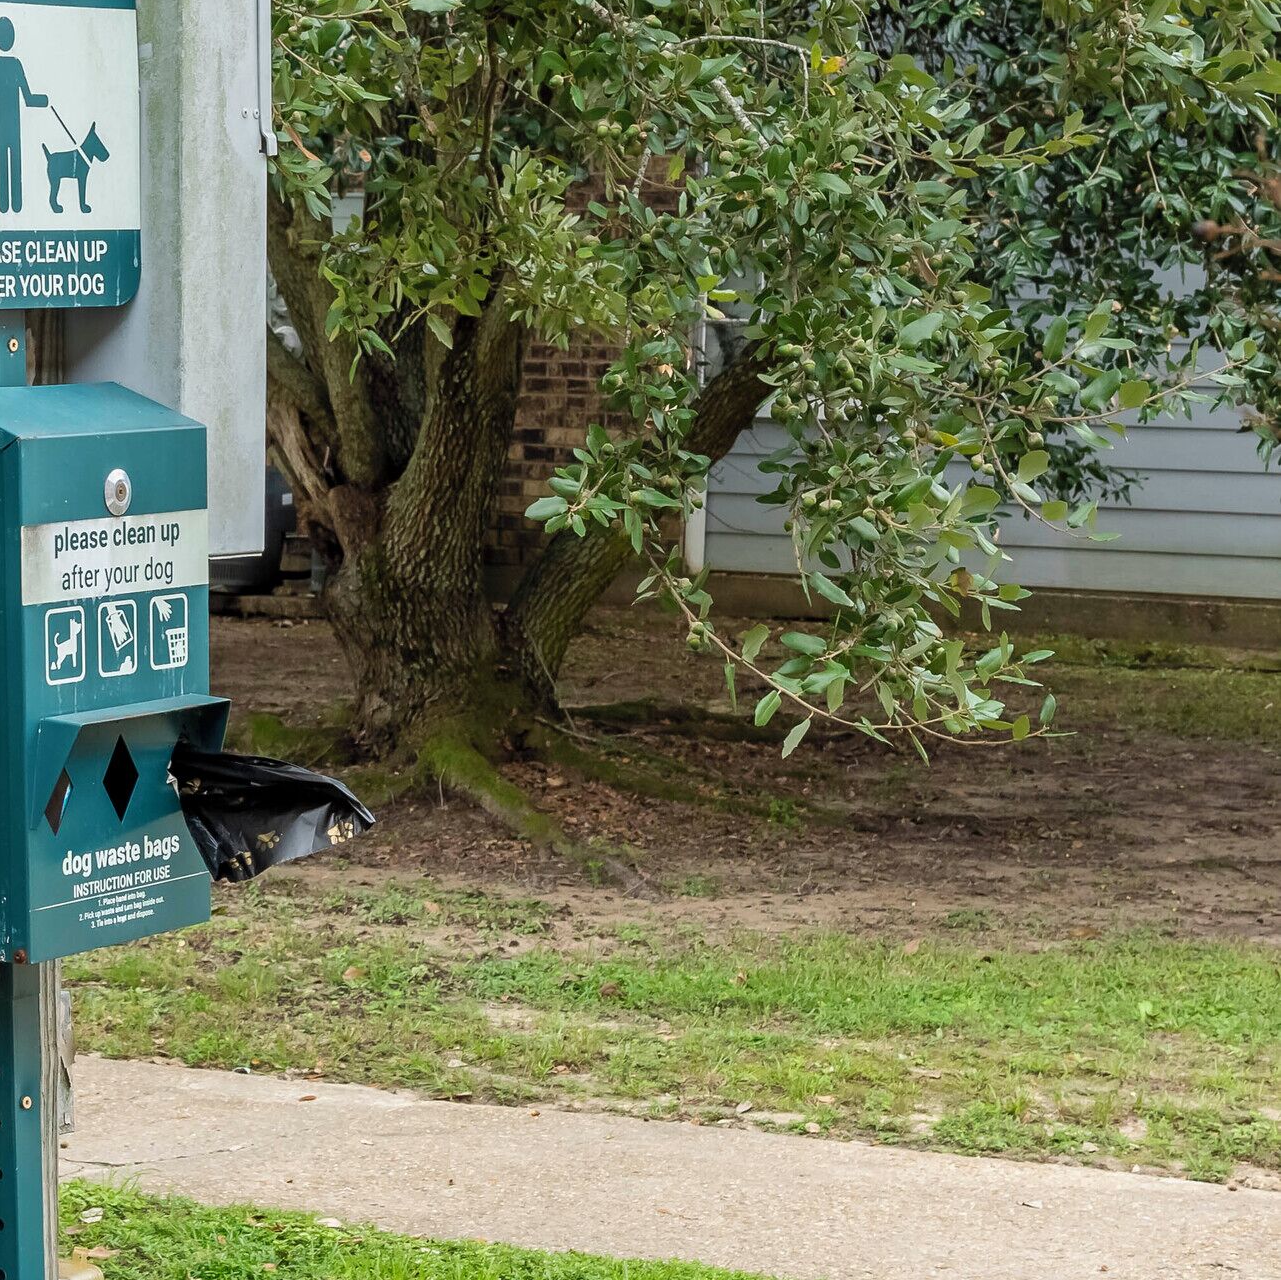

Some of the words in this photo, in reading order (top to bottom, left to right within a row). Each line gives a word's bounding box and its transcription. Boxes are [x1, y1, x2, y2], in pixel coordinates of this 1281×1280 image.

[25, 240, 79, 263] CLEAN
[84, 240, 108, 262] UP
[20, 274, 64, 297] YOUR
[68, 273, 105, 296] DOG
[54, 526, 108, 558] please
[113, 521, 156, 547] clean
[161, 522, 180, 546] up
[62, 564, 100, 591] after
[105, 564, 139, 592] your
[144, 557, 174, 584] dog
[62, 850, 92, 878] dog
[95, 841, 141, 869] waste
[144, 834, 180, 860] bags
[73, 873, 133, 899] INSTRUCTION
[134, 869, 152, 885] FOR
[153, 864, 171, 881] USE
[102, 897, 116, 905] Place
[115, 893, 128, 903] hand
[84, 911, 94, 920] Pick
[94, 910, 101, 918] up
[101, 907, 115, 916] waste
[96, 919, 104, 927] Tie
